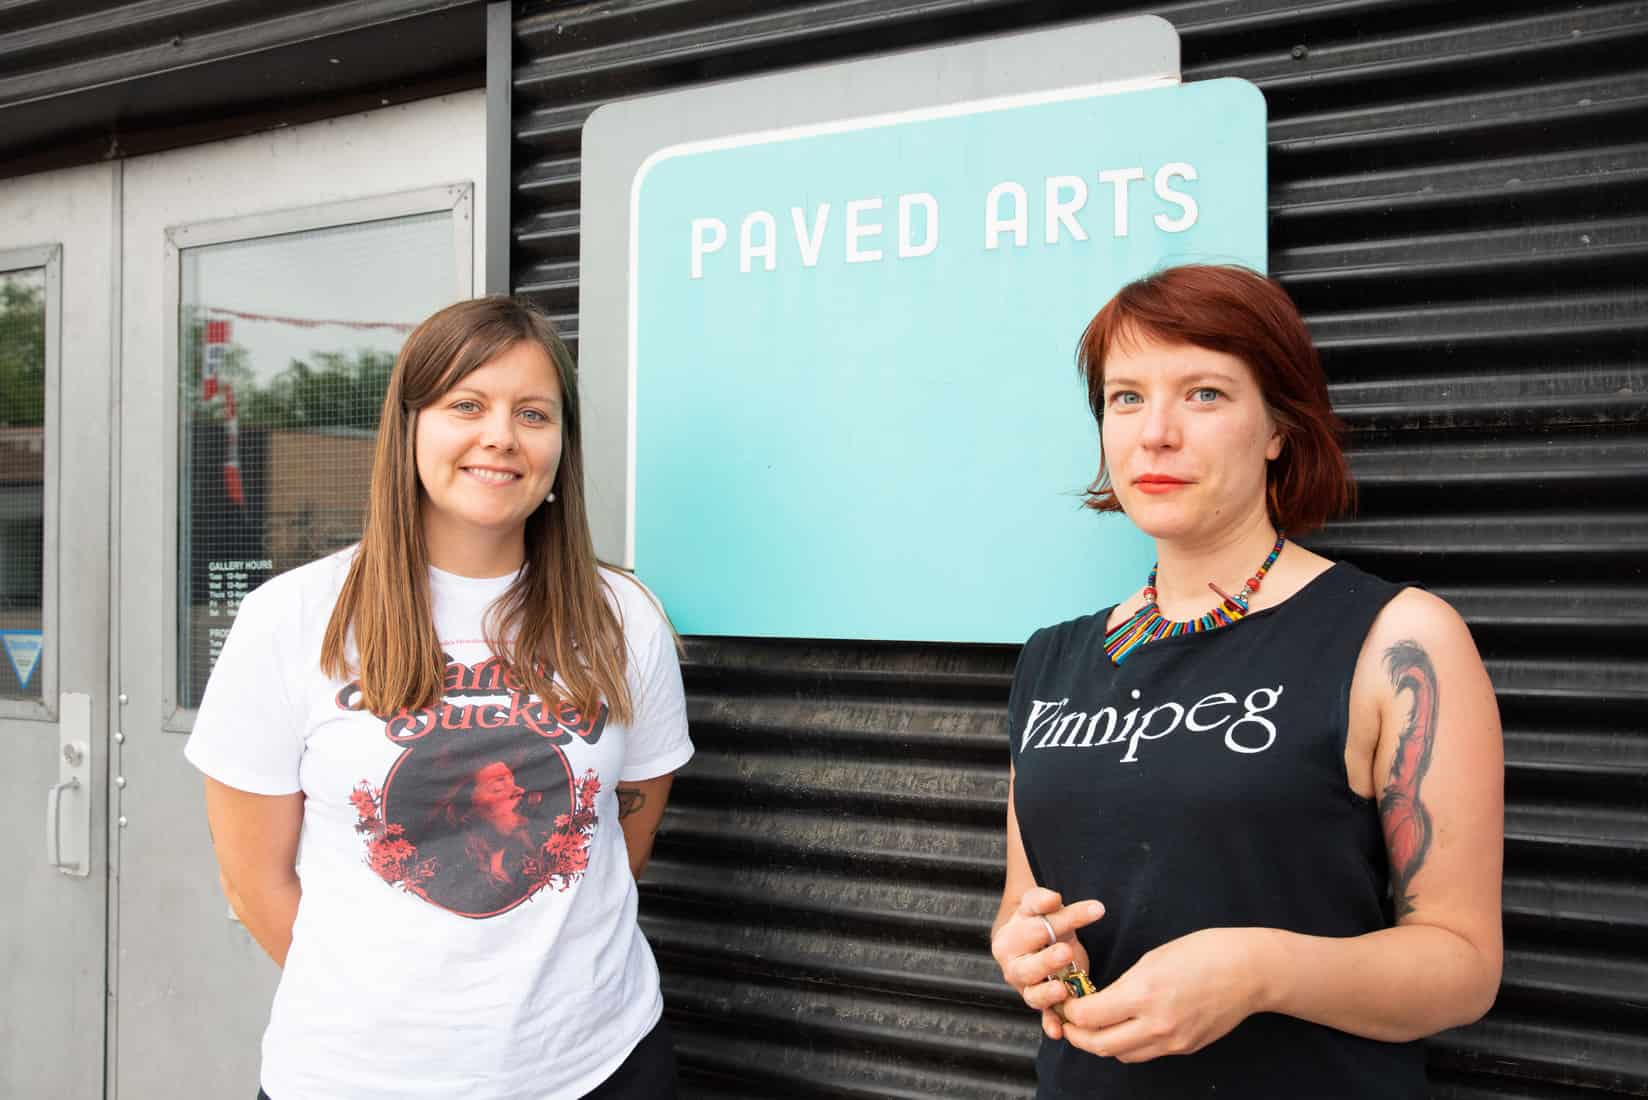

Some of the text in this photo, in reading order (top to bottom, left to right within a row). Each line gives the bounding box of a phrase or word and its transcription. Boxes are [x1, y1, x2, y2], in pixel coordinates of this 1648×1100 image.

[689, 162, 1200, 280] PAVED ARTS
[208, 559, 273, 571] GALLERY HOURS
